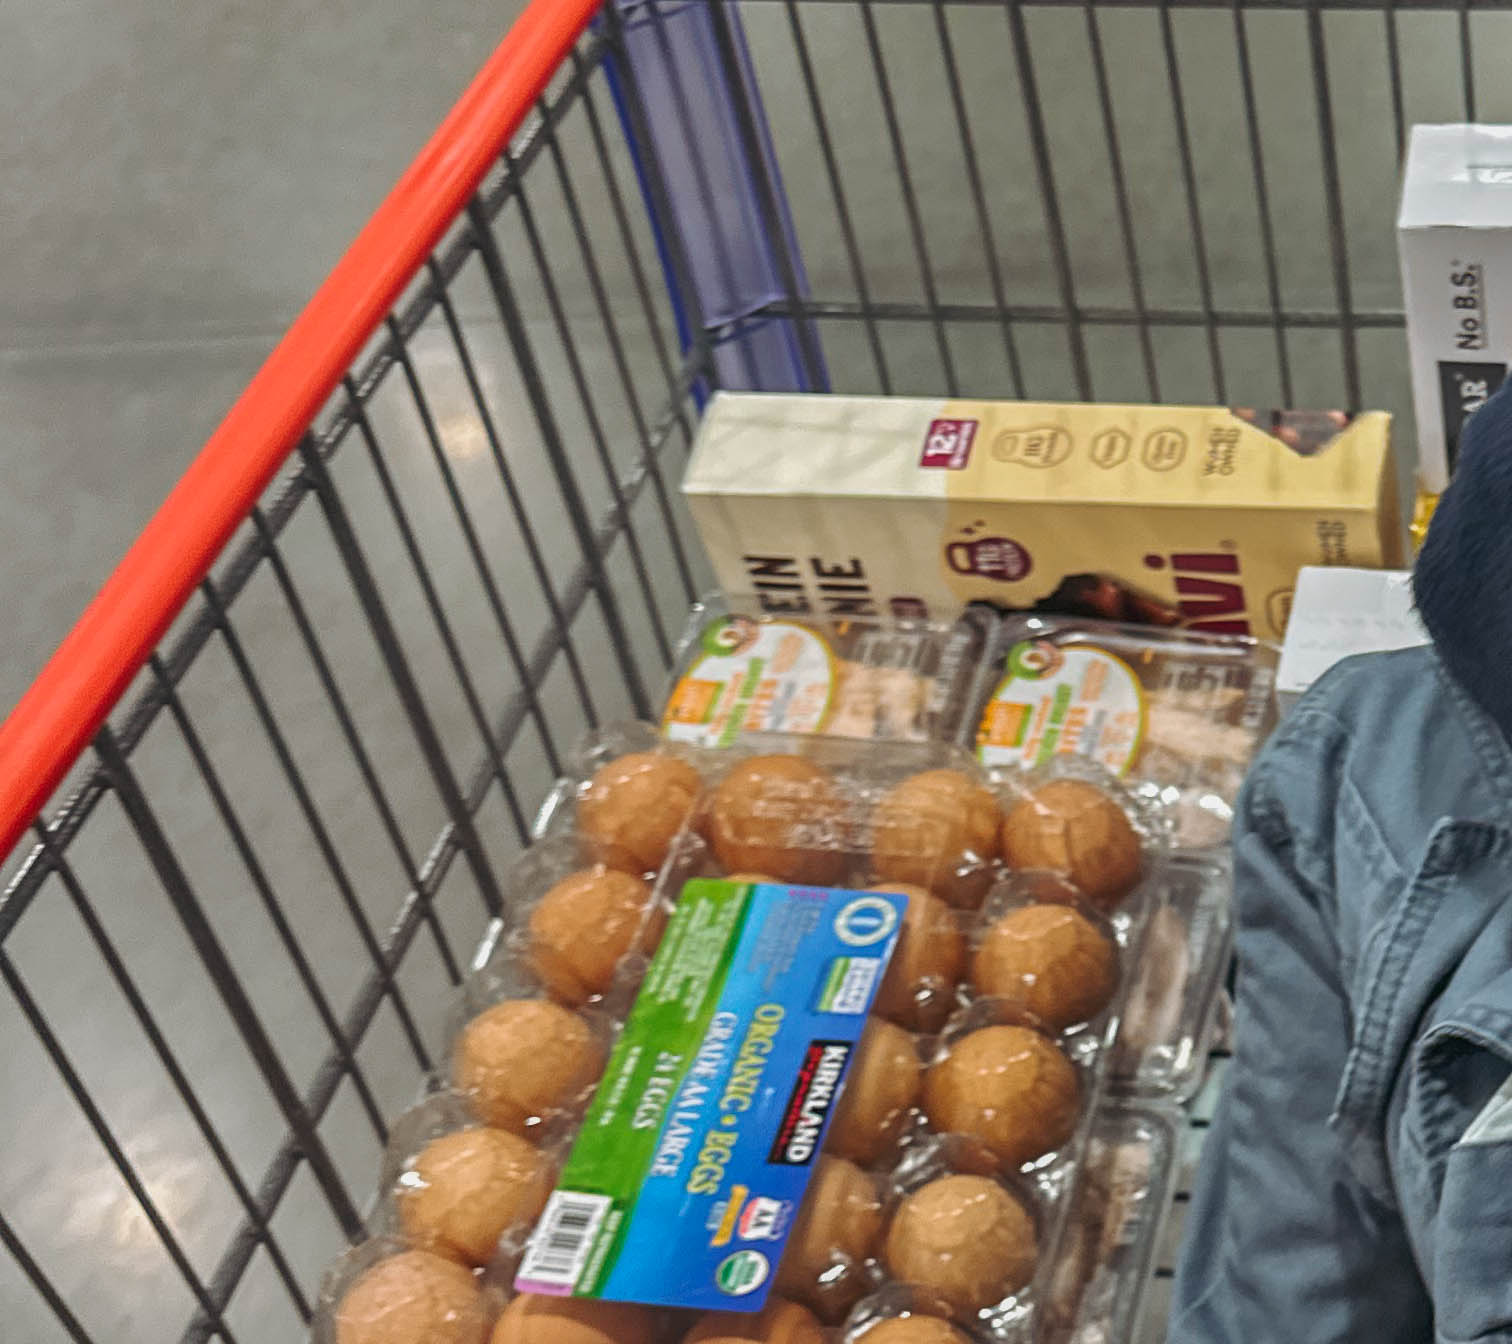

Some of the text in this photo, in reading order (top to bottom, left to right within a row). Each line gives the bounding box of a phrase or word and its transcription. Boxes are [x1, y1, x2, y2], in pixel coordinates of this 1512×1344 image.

[1455, 317, 1482, 350] No
[717, 1002, 788, 1112] ORGANIC
[783, 1045, 849, 1163] KIRKLAND
[647, 1110, 700, 1178] LARGE
[684, 1128, 740, 1196] EGGS
